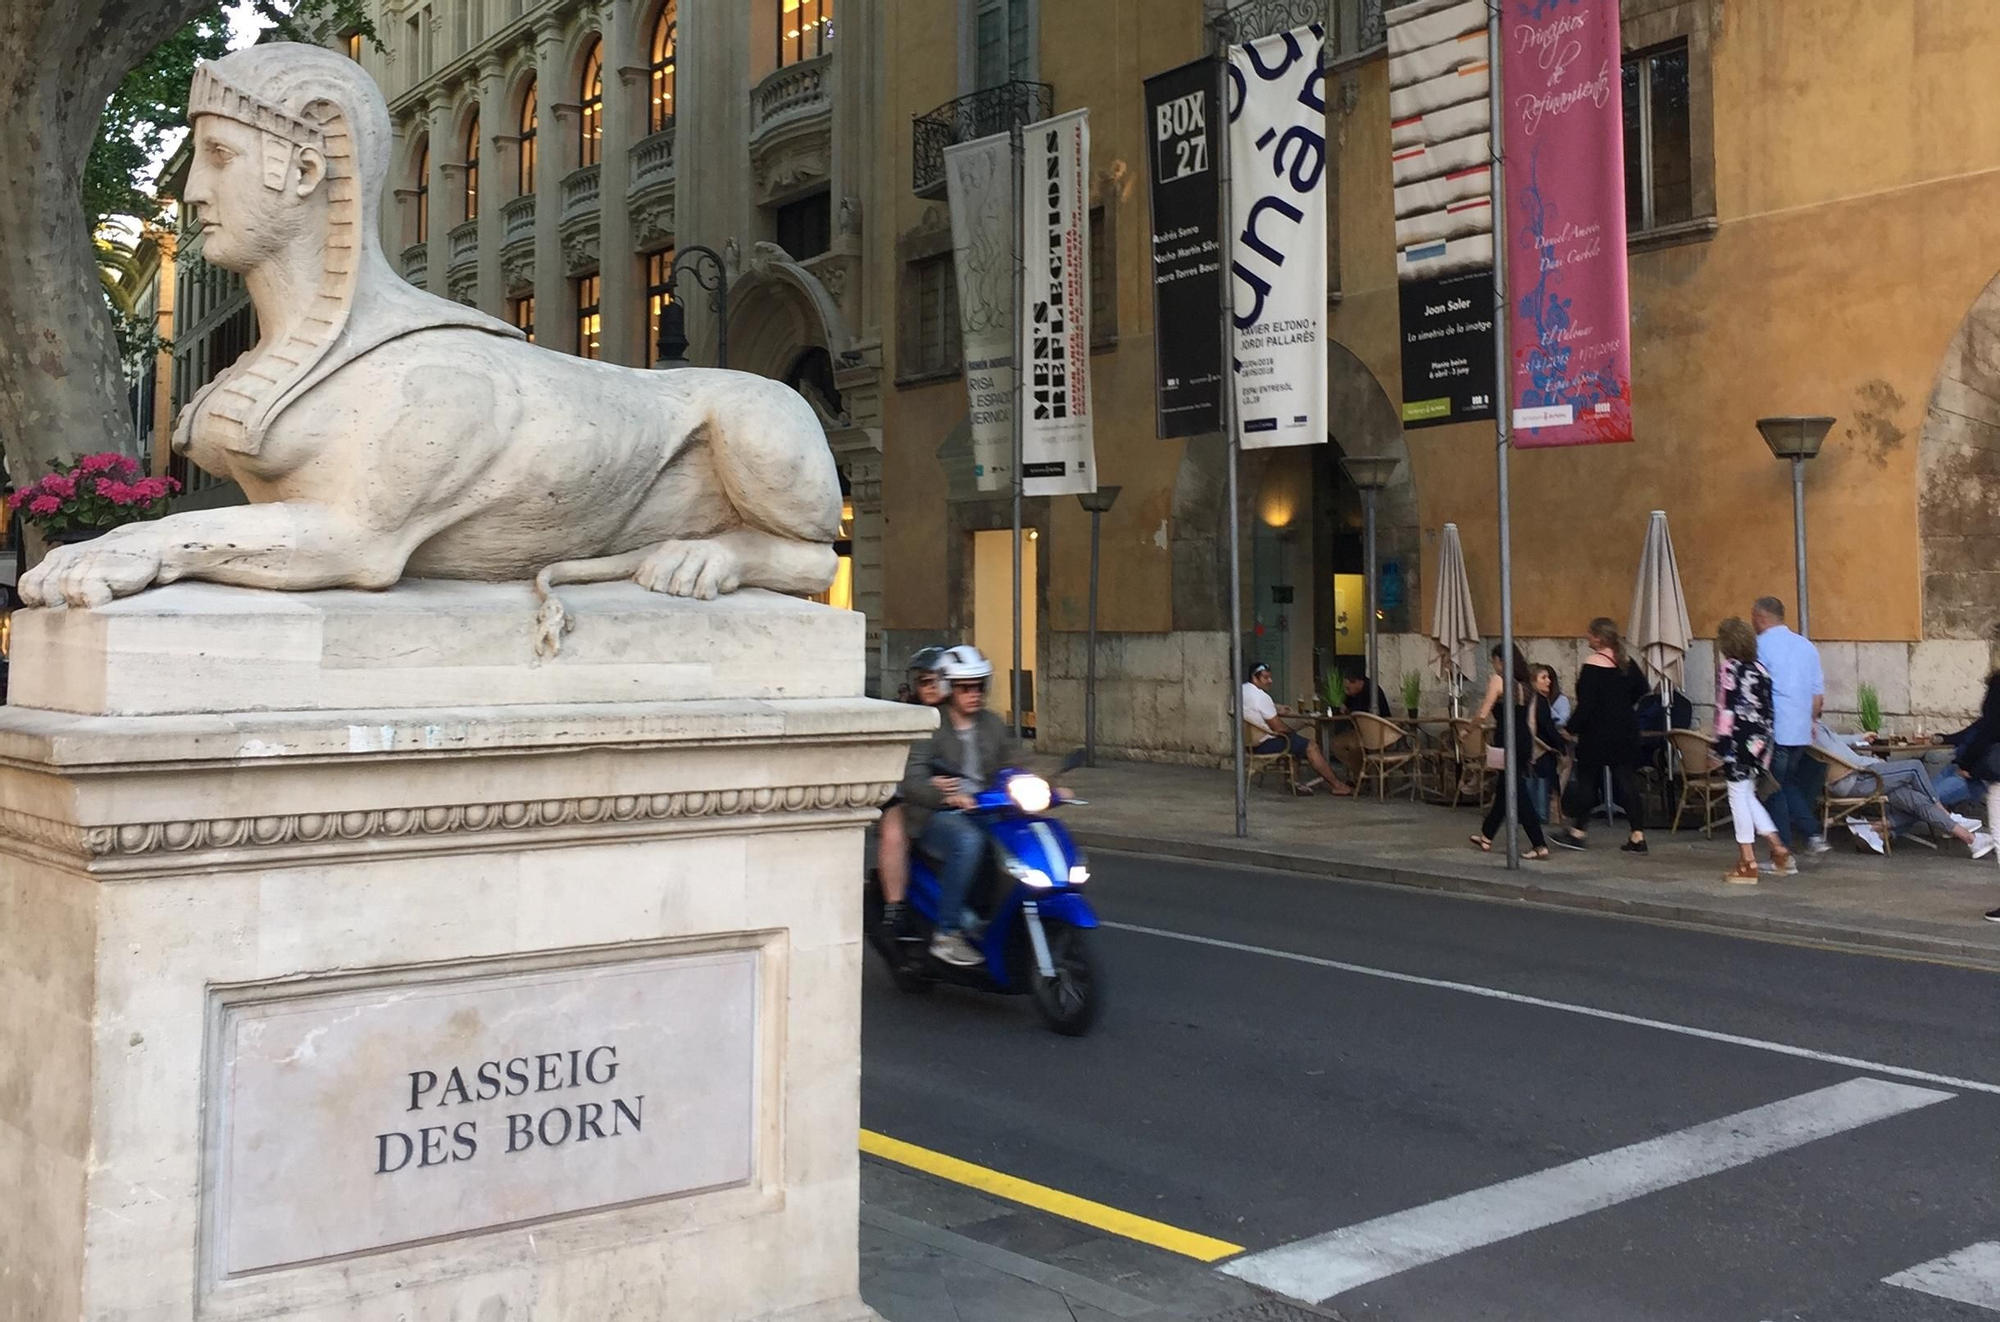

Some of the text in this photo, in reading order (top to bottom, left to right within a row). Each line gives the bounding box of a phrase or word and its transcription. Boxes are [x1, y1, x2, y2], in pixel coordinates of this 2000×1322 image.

[1157, 90, 1205, 142] BOX
[1176, 135, 1206, 178] 27
[1046, 129, 1067, 419] REFLECTIONS
[1272, 319, 1310, 333] ELTONO
[1424, 297, 1471, 317] Joan Soler
[1033, 301, 1049, 420] MEN'S
[1240, 330, 1316, 351] JORDI PALLARÈS
[406, 1045, 619, 1112] PASSEIG
[374, 1095, 645, 1175] DES BORN
